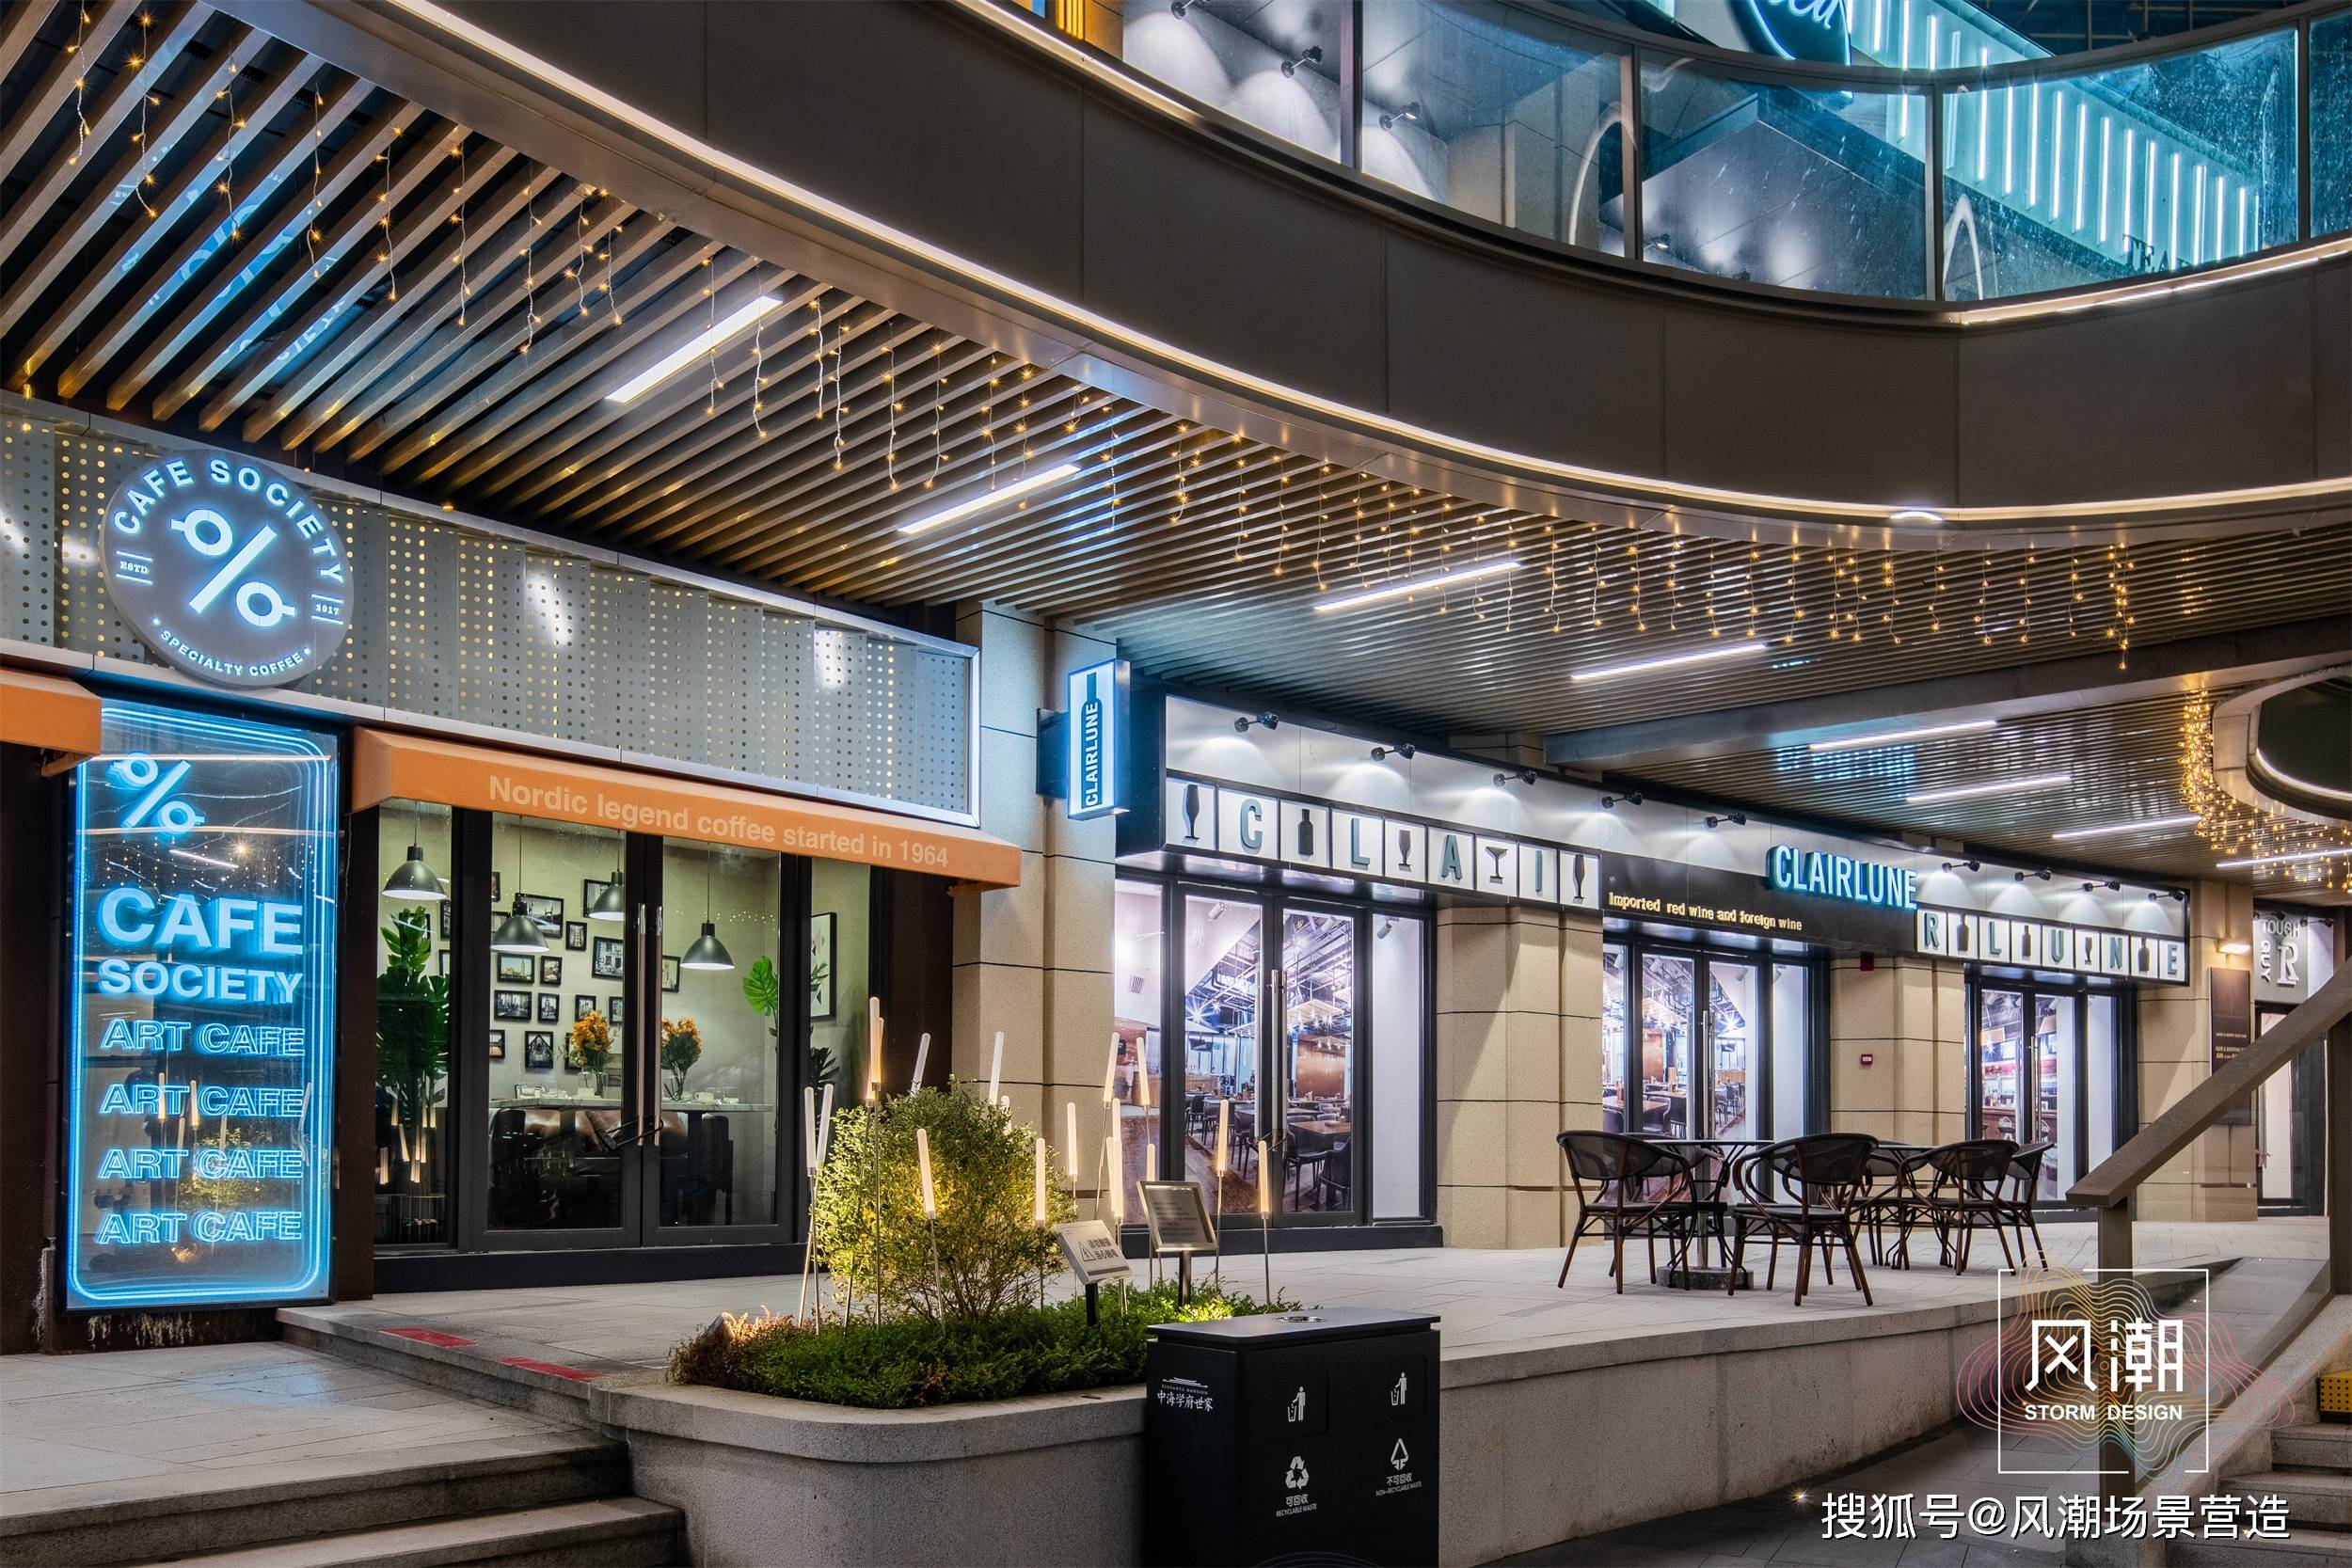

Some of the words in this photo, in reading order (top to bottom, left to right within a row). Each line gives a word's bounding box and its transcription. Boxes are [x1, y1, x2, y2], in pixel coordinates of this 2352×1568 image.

[114, 459, 194, 535] CAFE
[210, 459, 344, 584] SOCIETY
[119, 561, 150, 575] ESTD
[316, 604, 340, 616] 2017
[161, 630, 243, 676] SPECIALTY
[248, 653, 303, 677] COFFEE
[1085, 702, 1099, 807] CLAIRLUNE
[488, 774, 588, 815] Nordic
[597, 792, 689, 832] legend
[697, 814, 775, 843] coffee
[783, 826, 864, 856] started
[872, 836, 892, 858] in
[899, 840, 948, 868] 1964
[1770, 845, 1917, 910] CLAIRLUNE
[99, 887, 304, 956] CAFE
[1608, 892, 1661, 913] Imported
[1666, 902, 1685, 915] red
[1689, 906, 1713, 920] wine
[1717, 910, 1736, 923] and
[1740, 911, 1775, 929] foreign
[1778, 917, 1802, 931] wine
[2263, 919, 2300, 937] TOUGH
[99, 958, 304, 1004] SOCIETY
[2261, 940, 2271, 984] GUY
[101, 1018, 191, 1051] ART
[194, 1022, 305, 1056] CAFE
[100, 1083, 190, 1115] ART
[195, 1085, 305, 1117] CAFE
[99, 1148, 188, 1179] ART
[194, 1148, 304, 1179] CAFE
[98, 1212, 186, 1244] ART
[190, 1211, 303, 1242] CAFE
[1157, 1389, 1213, 1412] 中海学府世家
[1386, 1472, 1413, 1486] 不可回收
[1285, 1494, 1309, 1507] 可回收
